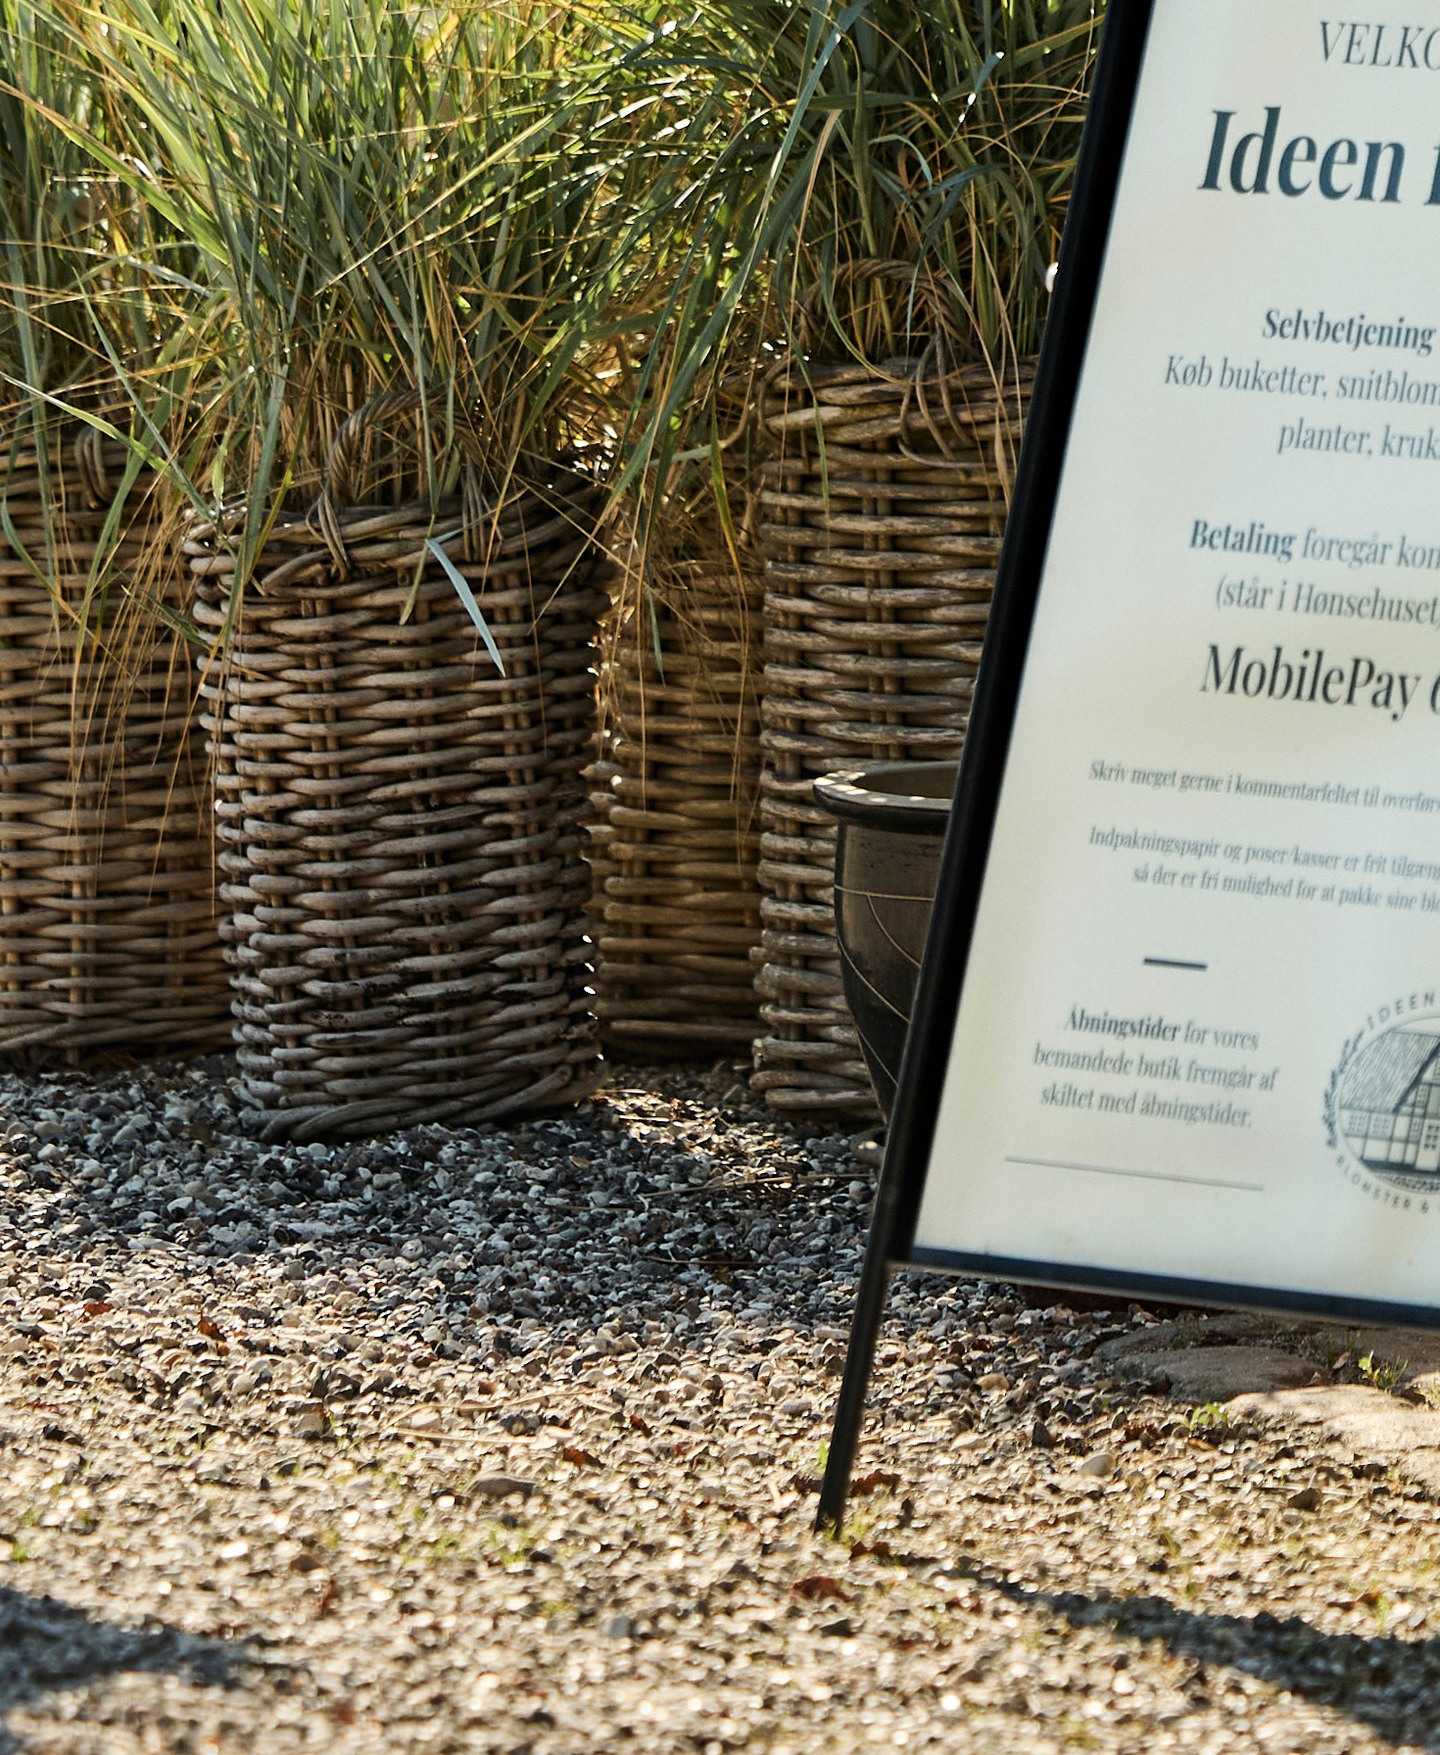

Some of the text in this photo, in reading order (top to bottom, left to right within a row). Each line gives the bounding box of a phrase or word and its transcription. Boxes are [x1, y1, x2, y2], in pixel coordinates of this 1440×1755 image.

[1197, 106, 1407, 203] Ideen
[1262, 308, 1437, 357] Selvbetjening
[1163, 354, 1213, 388] Køb
[1218, 357, 1328, 400] buketter,
[1277, 417, 1373, 459] planter,
[1189, 520, 1298, 562] Betaling
[1300, 527, 1394, 570] foregår
[1215, 573, 1274, 612] (står
[1277, 580, 1289, 612] i
[1198, 643, 1421, 722] MobilePay
[1089, 758, 1126, 783] Skriv
[1130, 767, 1177, 790] meget
[1179, 772, 1223, 793] gerne
[1225, 774, 1234, 794] i
[1234, 773, 1361, 806] kommentarfeltet
[1362, 785, 1380, 808] til
[1088, 824, 1221, 861] Indpakningspapir
[1223, 841, 1243, 862] og
[1344, 855, 1361, 873] er
[1363, 852, 1388, 875] frit
[1131, 862, 1150, 884] så
[1152, 863, 1178, 886] der
[1180, 872, 1198, 888] er
[1200, 868, 1220, 891] fri
[1221, 873, 1294, 900] mulighed
[1295, 879, 1320, 902] for
[1320, 885, 1337, 903] at
[1338, 885, 1383, 907] pakke
[1385, 890, 1418, 911] sine
[1064, 1003, 1260, 1051] Åbningstider for vores
[1366, 989, 1436, 1031] IDEEN
[1032, 1042, 1280, 1092] bemandede butik fremgår af
[1040, 1080, 1252, 1129] skiltet med åbningstider.
